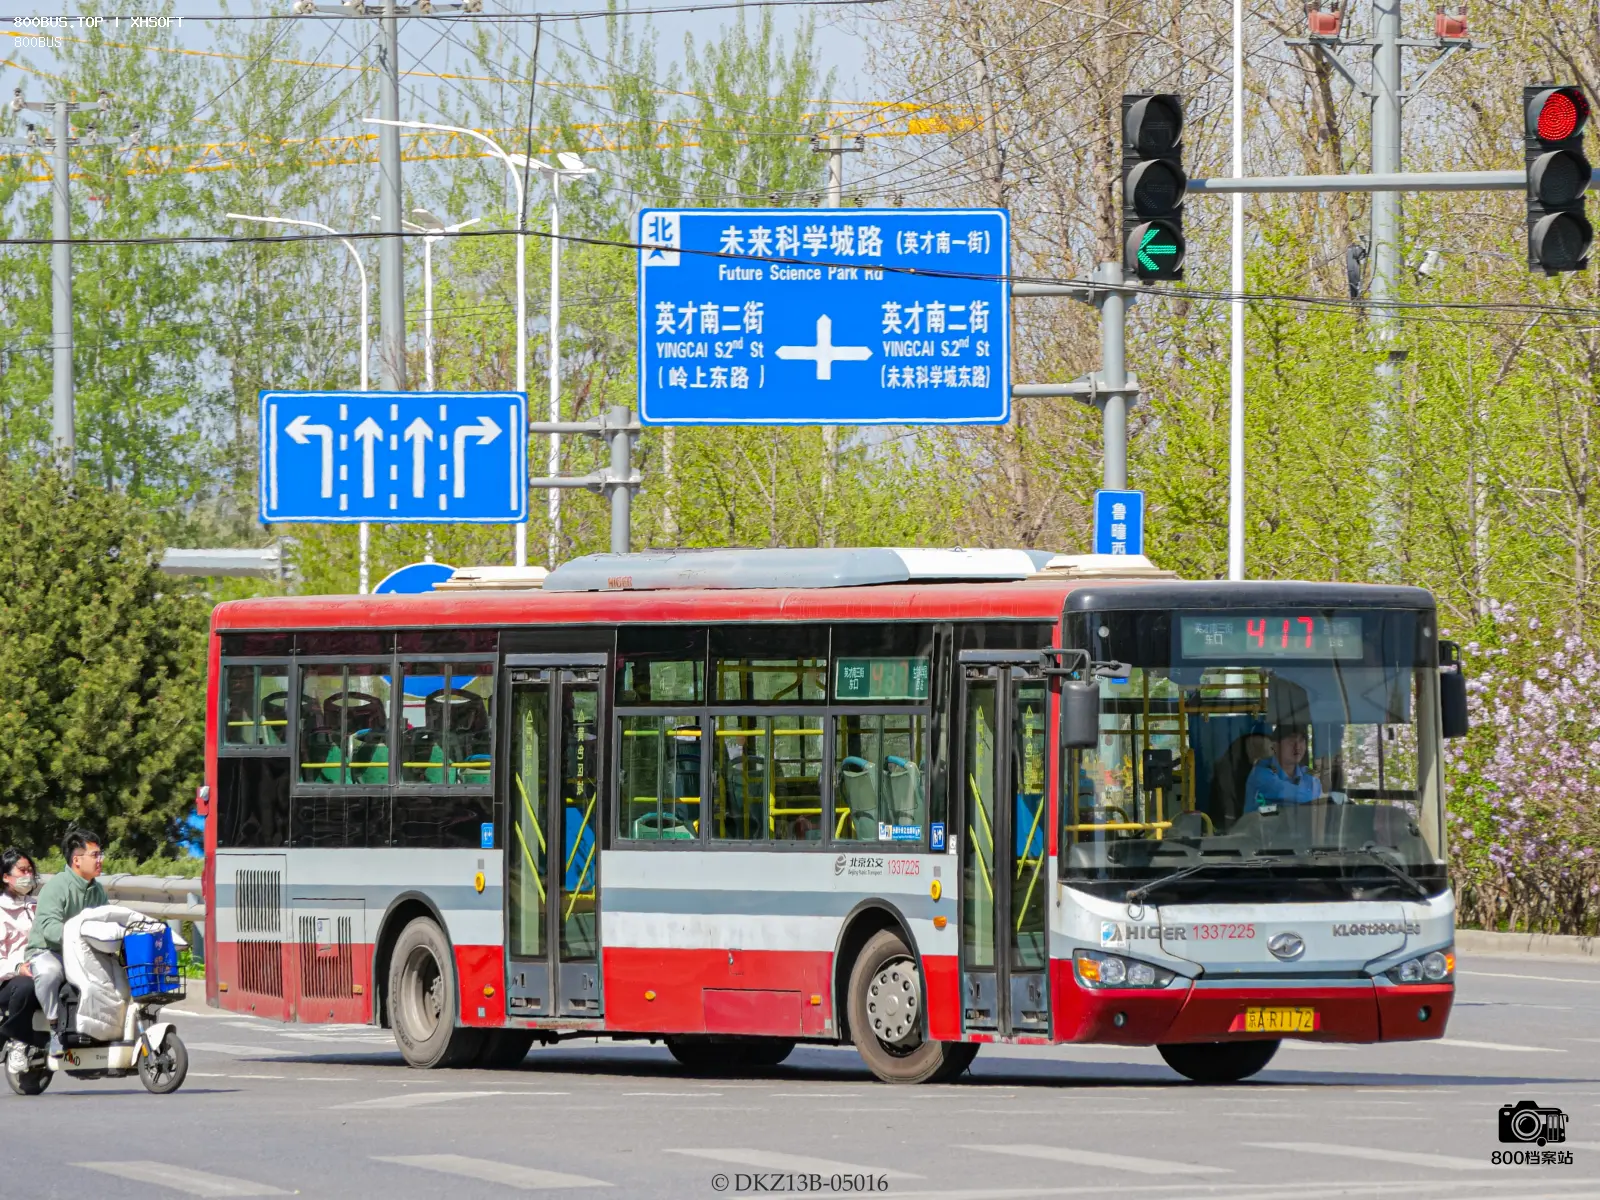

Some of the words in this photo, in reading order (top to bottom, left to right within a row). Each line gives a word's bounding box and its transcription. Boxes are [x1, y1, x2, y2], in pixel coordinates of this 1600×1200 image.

[649, 216, 674, 242] 北
[719, 224, 884, 257] 未来科学城路
[896, 230, 991, 255] (英才南一街)
[718, 264, 763, 281] Future
[769, 264, 822, 281] Science
[828, 264, 858, 280] Park
[864, 264, 884, 280] Rd
[655, 300, 764, 335] 英才南二街
[881, 300, 989, 334] 英才南二街
[656, 341, 708, 358] YINGCAI
[750, 341, 764, 358] St
[882, 340, 935, 357] YINGCAI
[976, 340, 990, 357] St
[881, 364, 991, 389] (未来科学城东路)
[1247, 616, 1314, 648] 417
[849, 857, 883, 868] 北京公交
[887, 859, 920, 875] 1337225
[1125, 925, 1187, 941] HIGER
[1192, 924, 1256, 941] 1337225
